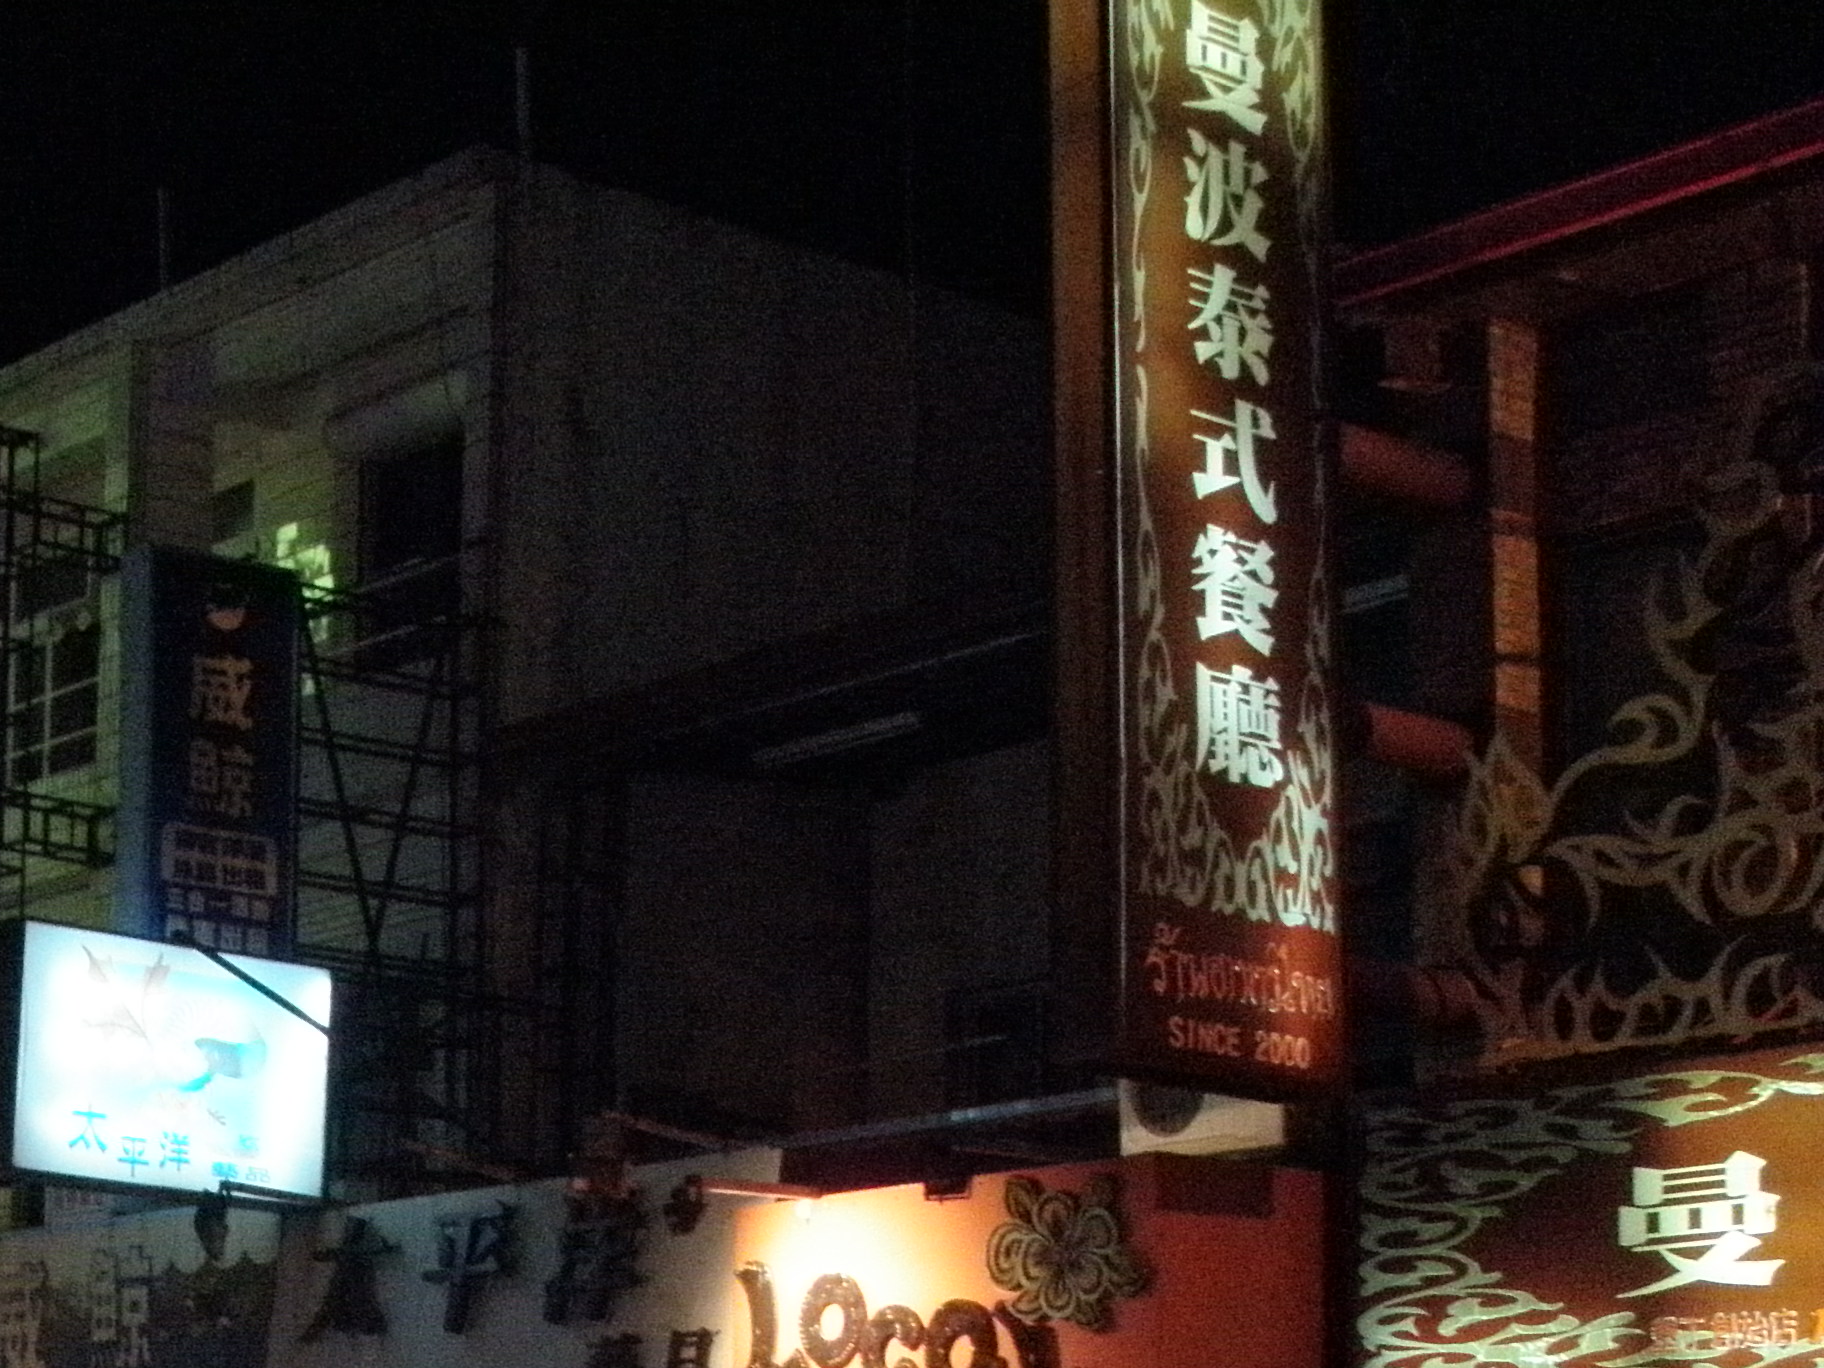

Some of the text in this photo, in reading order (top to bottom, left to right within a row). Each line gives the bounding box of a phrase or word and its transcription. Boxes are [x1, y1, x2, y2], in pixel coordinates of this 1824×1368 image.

[1182, 0, 1285, 785] 曼波泰式餐廳
[1254, 1030, 1310, 1069] 2000
[68, 1103, 191, 1178] 太平洋
[1616, 1150, 1787, 1298] 曼
